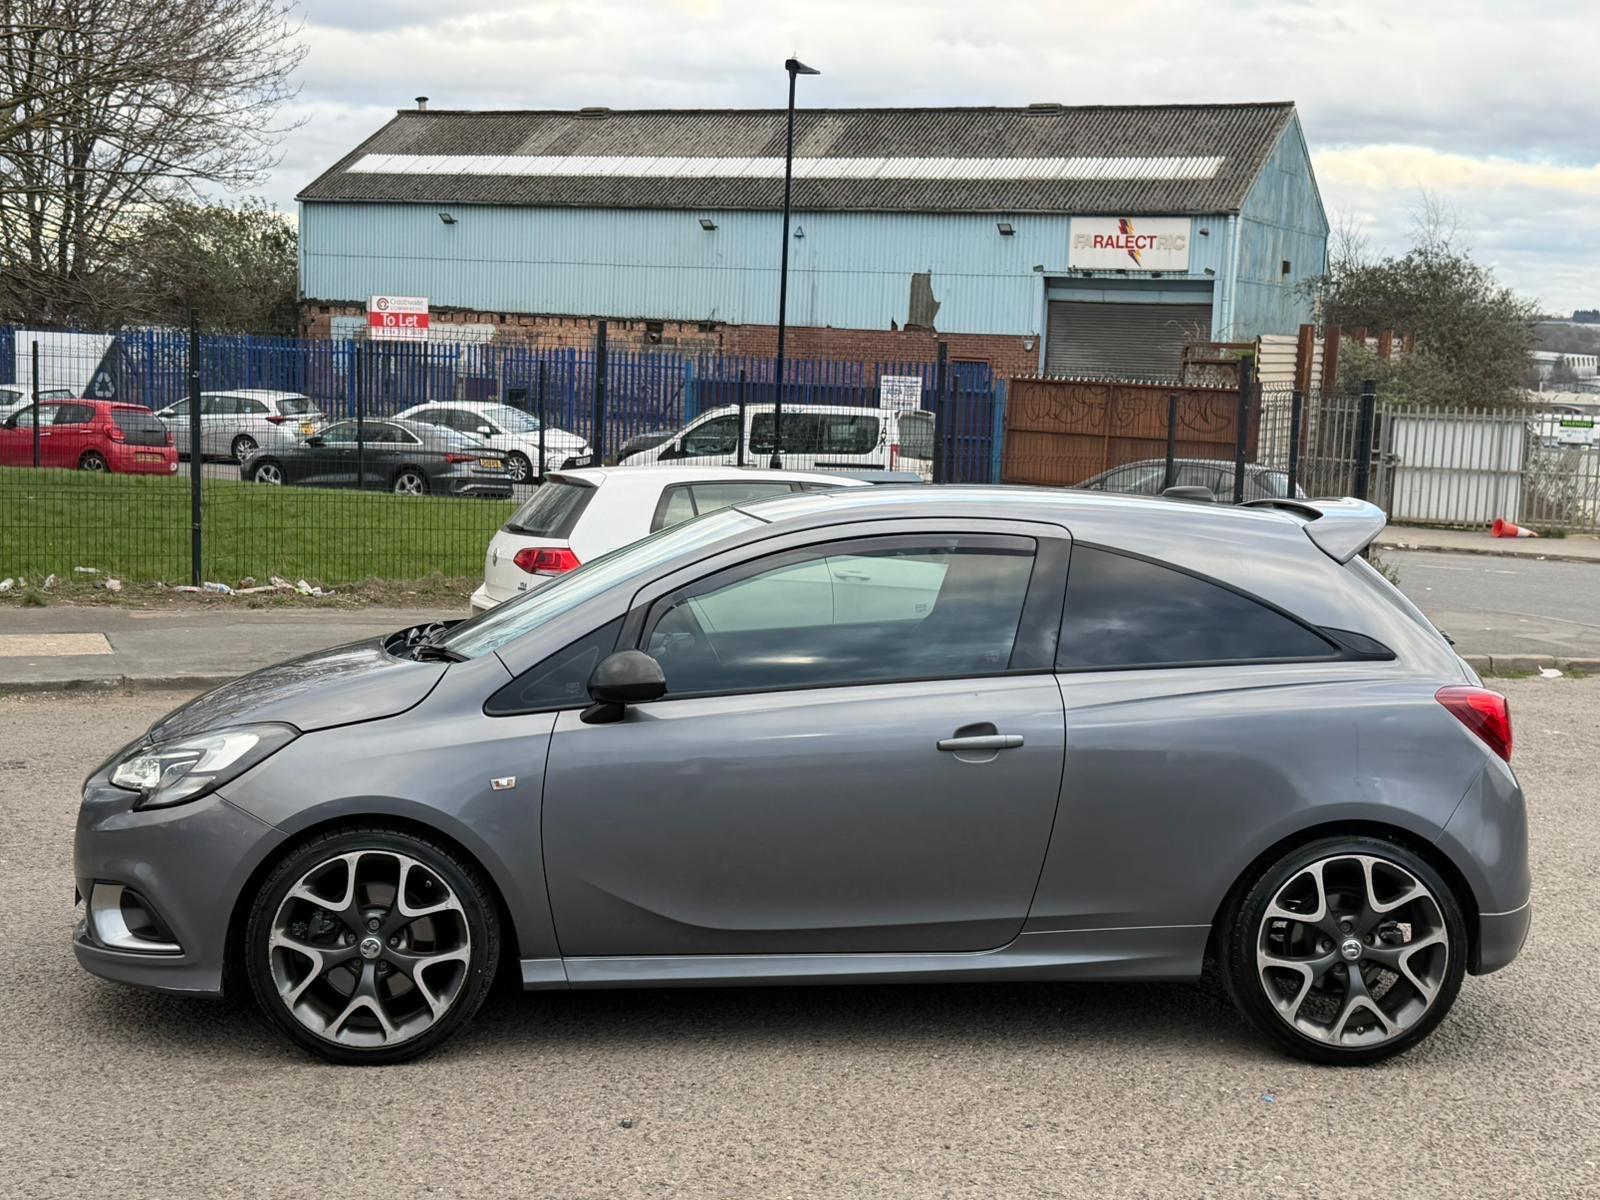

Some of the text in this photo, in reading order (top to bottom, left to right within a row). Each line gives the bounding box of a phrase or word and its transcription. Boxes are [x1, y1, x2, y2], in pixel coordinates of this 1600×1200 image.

[380, 313, 418, 328] To Let
[879, 417, 889, 454] TAXI
